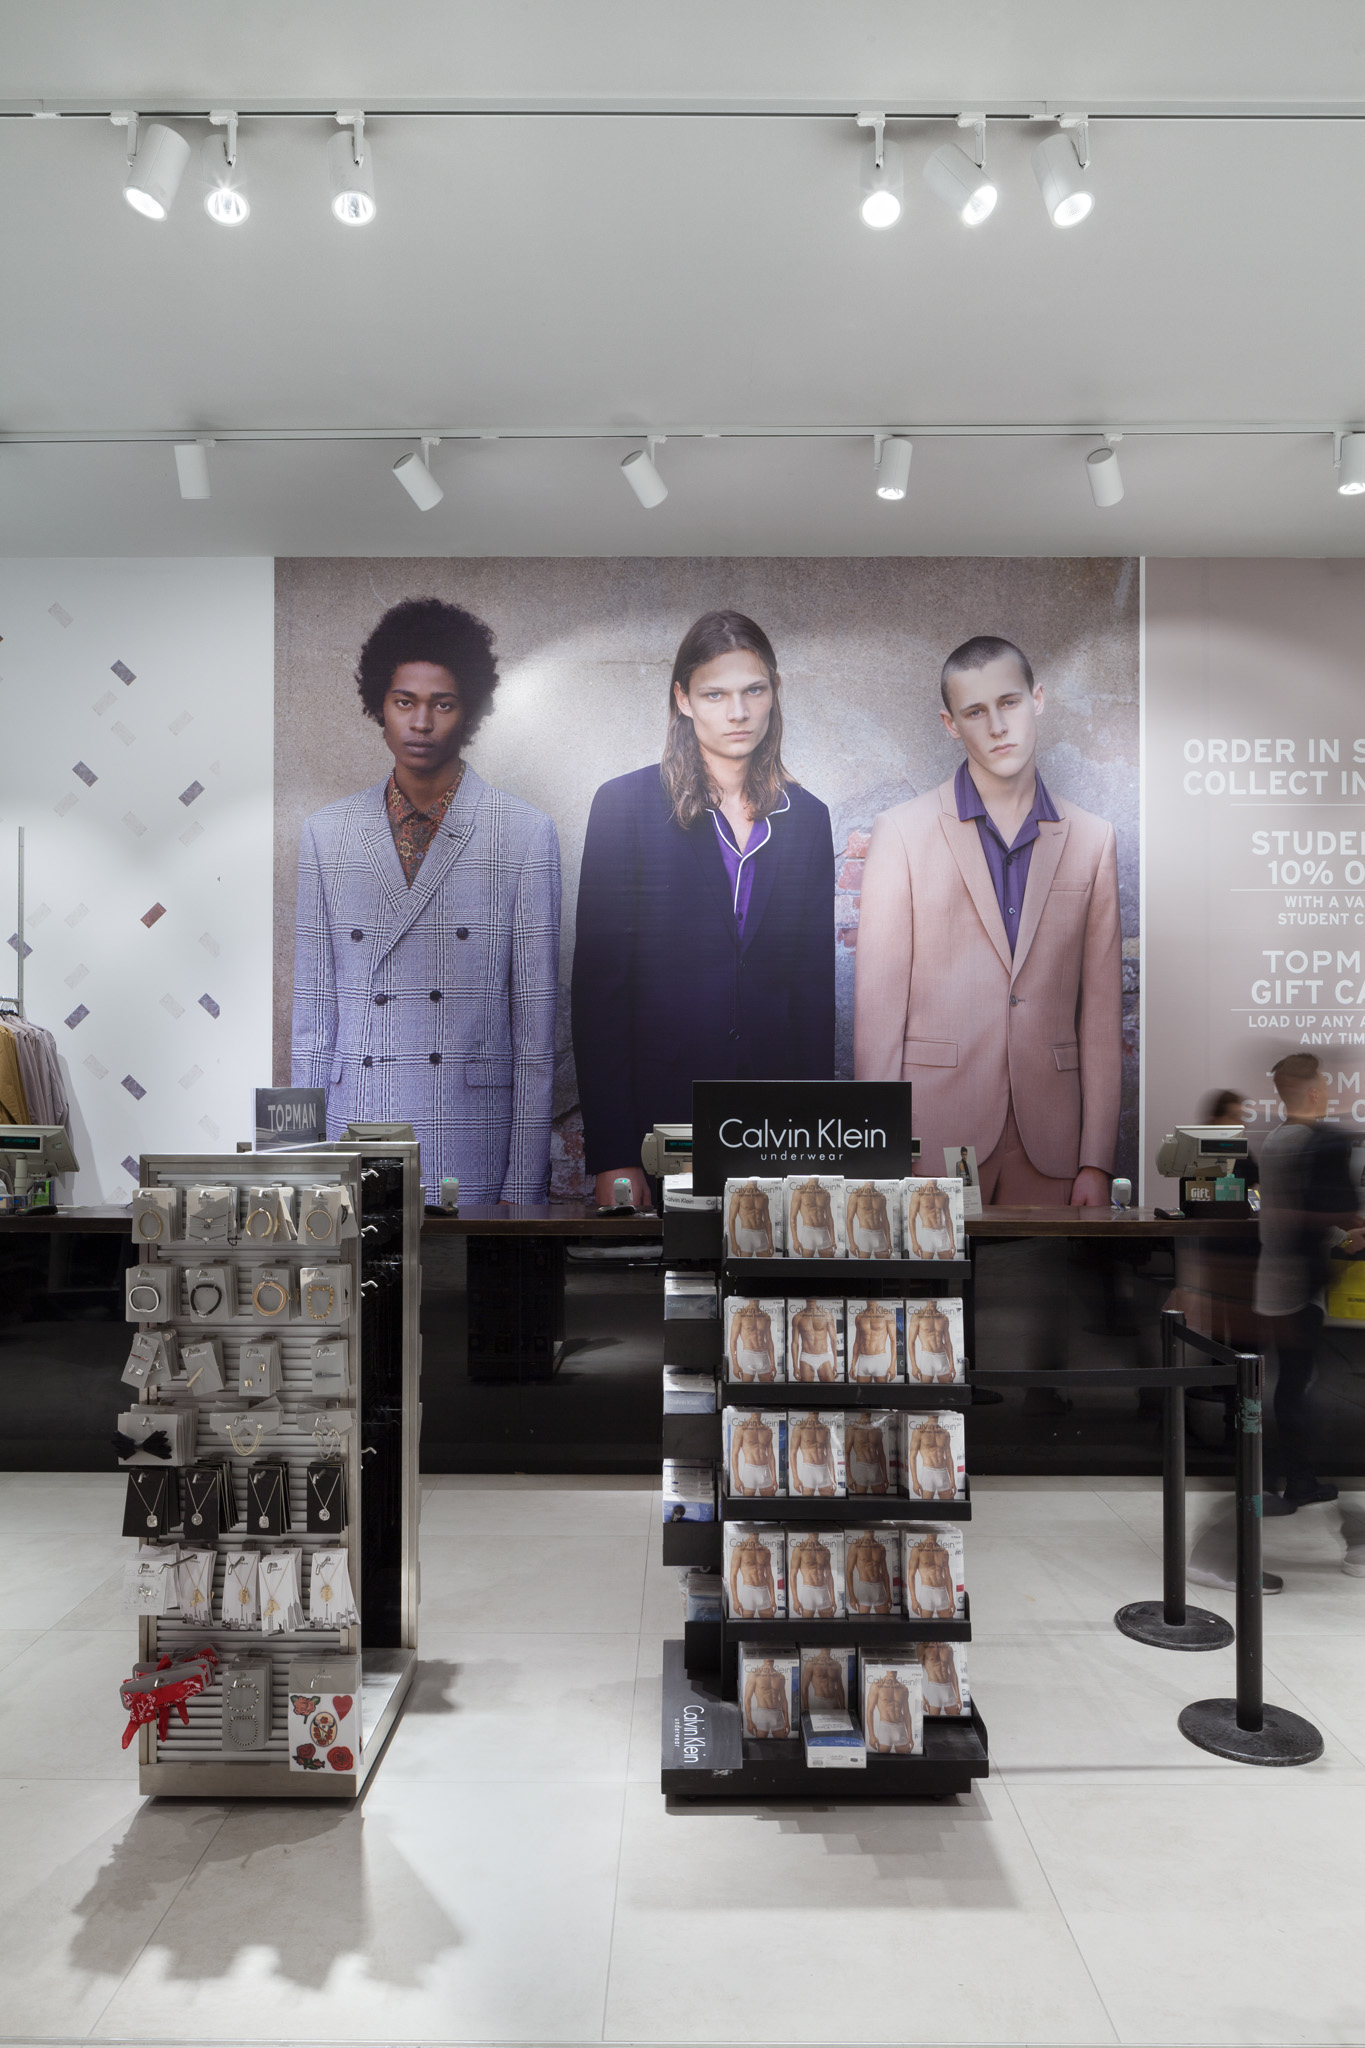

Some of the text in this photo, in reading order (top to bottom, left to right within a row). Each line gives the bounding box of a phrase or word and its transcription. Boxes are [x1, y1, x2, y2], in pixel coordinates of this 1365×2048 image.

[1183, 738, 1296, 763] ORDER
[1308, 738, 1340, 763] IN
[1183, 770, 1329, 796] COLLECT
[1251, 830, 1365, 856] STUDE
[1267, 860, 1334, 885] 10%
[1284, 895, 1365, 908] WITH A VA
[1278, 912, 1364, 925] STUDENT C
[1262, 950, 1361, 974] TOPM
[1251, 979, 1324, 1005] GIFT
[1248, 1015, 1290, 1028] LOAD
[1295, 1015, 1317, 1028] UP
[1321, 1015, 1355, 1028] ANY
[1300, 1032, 1365, 1045] ANY TIM
[267, 1103, 317, 1132] TOPMAN
[718, 1118, 886, 1149] Calvin Klein
[760, 1150, 843, 1161] underwear
[1190, 1187, 1211, 1199] Gift
[683, 1704, 707, 1763] Calvin Klein
